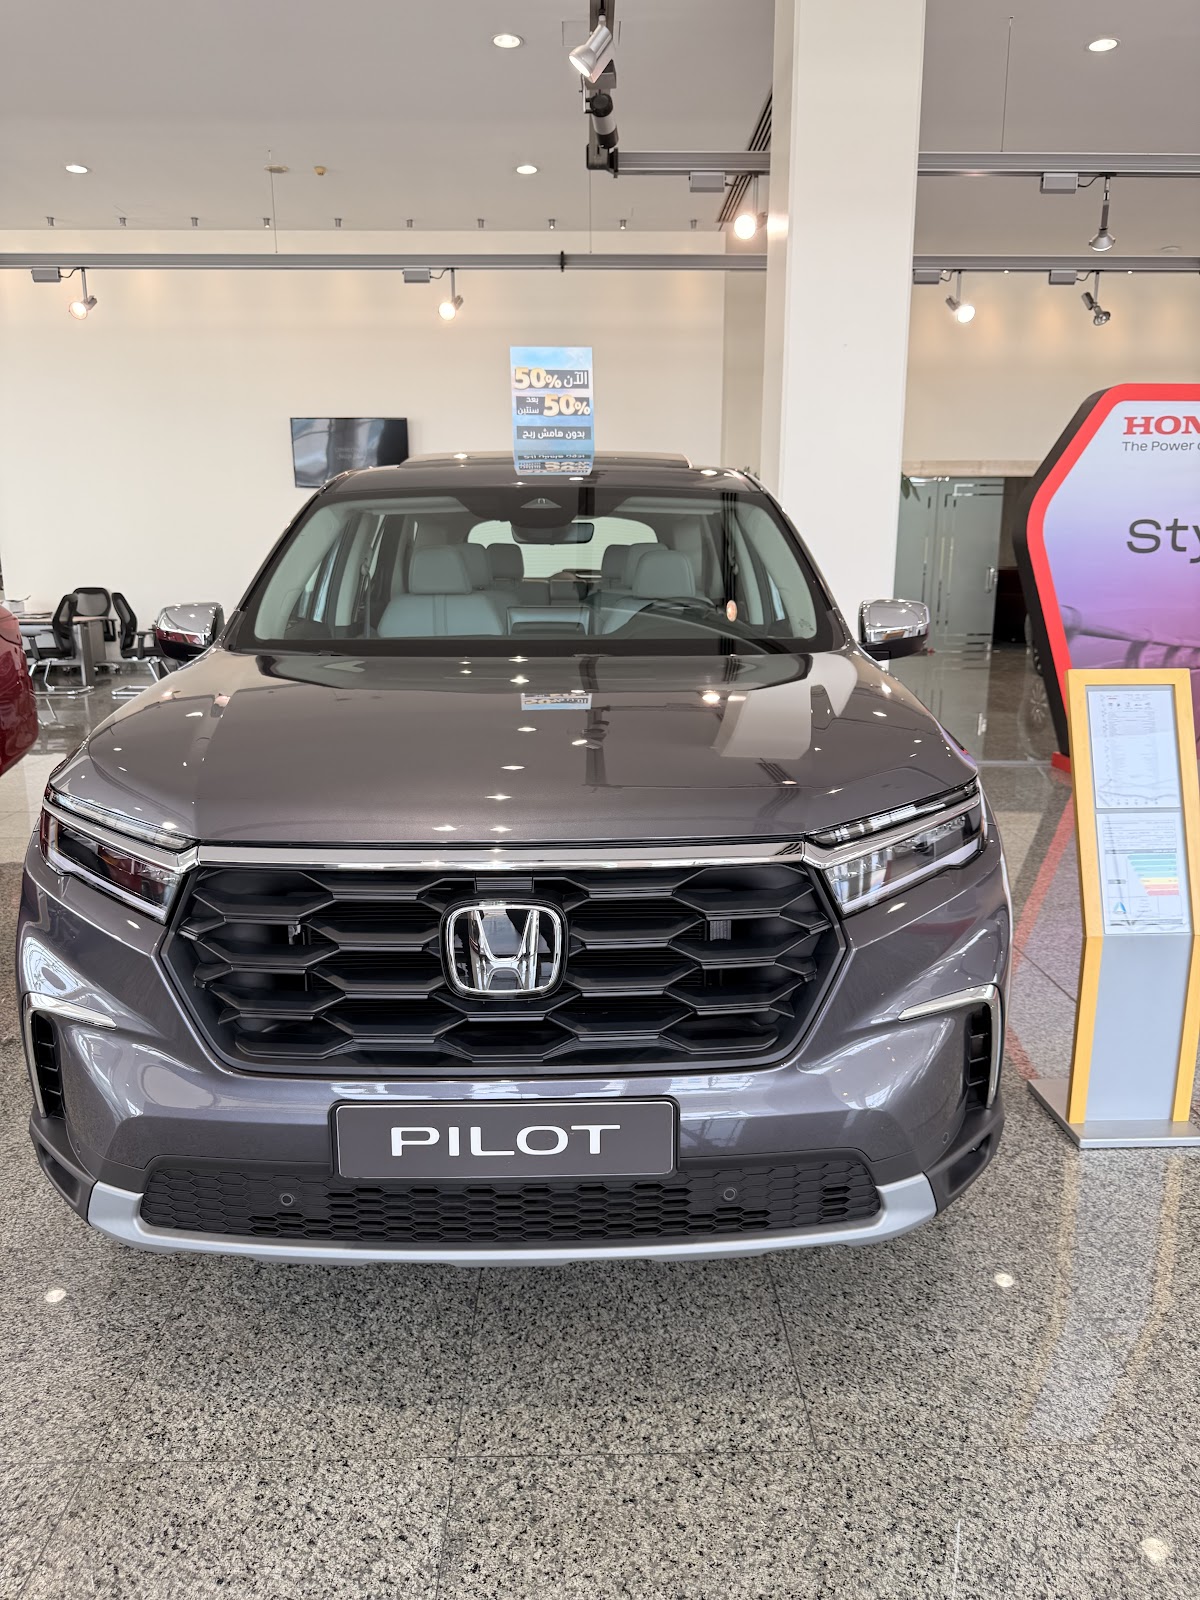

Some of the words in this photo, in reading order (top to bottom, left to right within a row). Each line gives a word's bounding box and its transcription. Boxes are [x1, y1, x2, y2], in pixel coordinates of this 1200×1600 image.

[514, 367, 562, 390] 50%
[564, 371, 588, 388] الآن
[526, 397, 539, 405] بعد
[543, 394, 591, 417] 50%
[517, 406, 540, 416] سنتين
[522, 430, 536, 440] ربح
[537, 427, 564, 440] هامش
[565, 430, 585, 440] بدون
[1122, 441, 1148, 452] The
[1151, 441, 1194, 452] Power
[390, 1124, 621, 1157] PILOT
